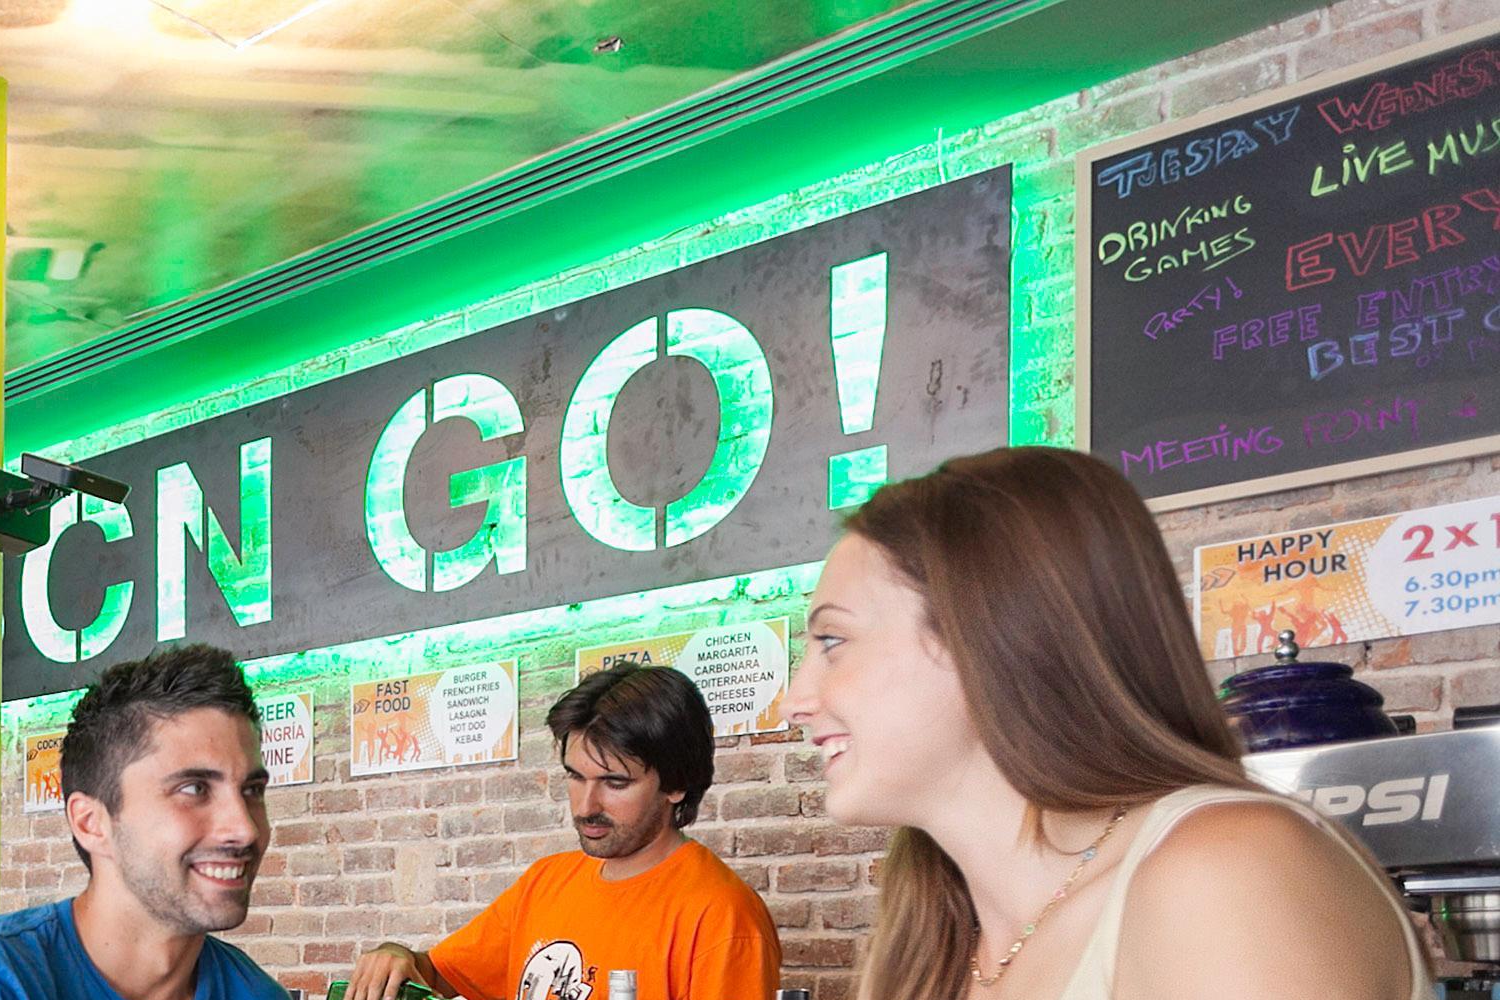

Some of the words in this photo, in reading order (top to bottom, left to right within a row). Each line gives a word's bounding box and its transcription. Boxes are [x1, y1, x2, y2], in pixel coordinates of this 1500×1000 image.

[1316, 49, 1500, 135] WEDNES
[1097, 105, 1300, 199] TUESDAY
[1098, 194, 1252, 265] DRINKING
[1124, 227, 1256, 282] GAMES
[1143, 276, 1244, 341] PARTY!
[1213, 303, 1322, 361] FREE
[1307, 307, 1466, 381] BEST
[19, 436, 274, 664] CN
[365, 251, 889, 593] GO!
[1119, 423, 1285, 478] MEETING
[1237, 529, 1334, 562] HAPPY
[1263, 553, 1348, 583] HOUR
[705, 631, 752, 648] CHICKEN
[697, 644, 759, 662] MARGARITA
[694, 658, 761, 676] CARBONARA
[453, 670, 488, 685] BURGER
[693, 671, 775, 689] EDITERRANEAN
[376, 679, 409, 698] FAST
[442, 684, 474, 699] FRENCH
[476, 681, 501, 695] FRIES
[707, 688, 756, 702] CHEESES
[374, 695, 411, 715] FOOD
[447, 695, 490, 710] SANDWICH
[708, 701, 755, 716] EPERONI
[448, 708, 488, 722] LASAGNA
[262, 720, 306, 744] NGRÍA
[450, 724, 467, 734] HOT
[468, 720, 487, 733] DOG
[454, 731, 484, 745] KEBAB
[1297, 774, 1450, 827] PSI
